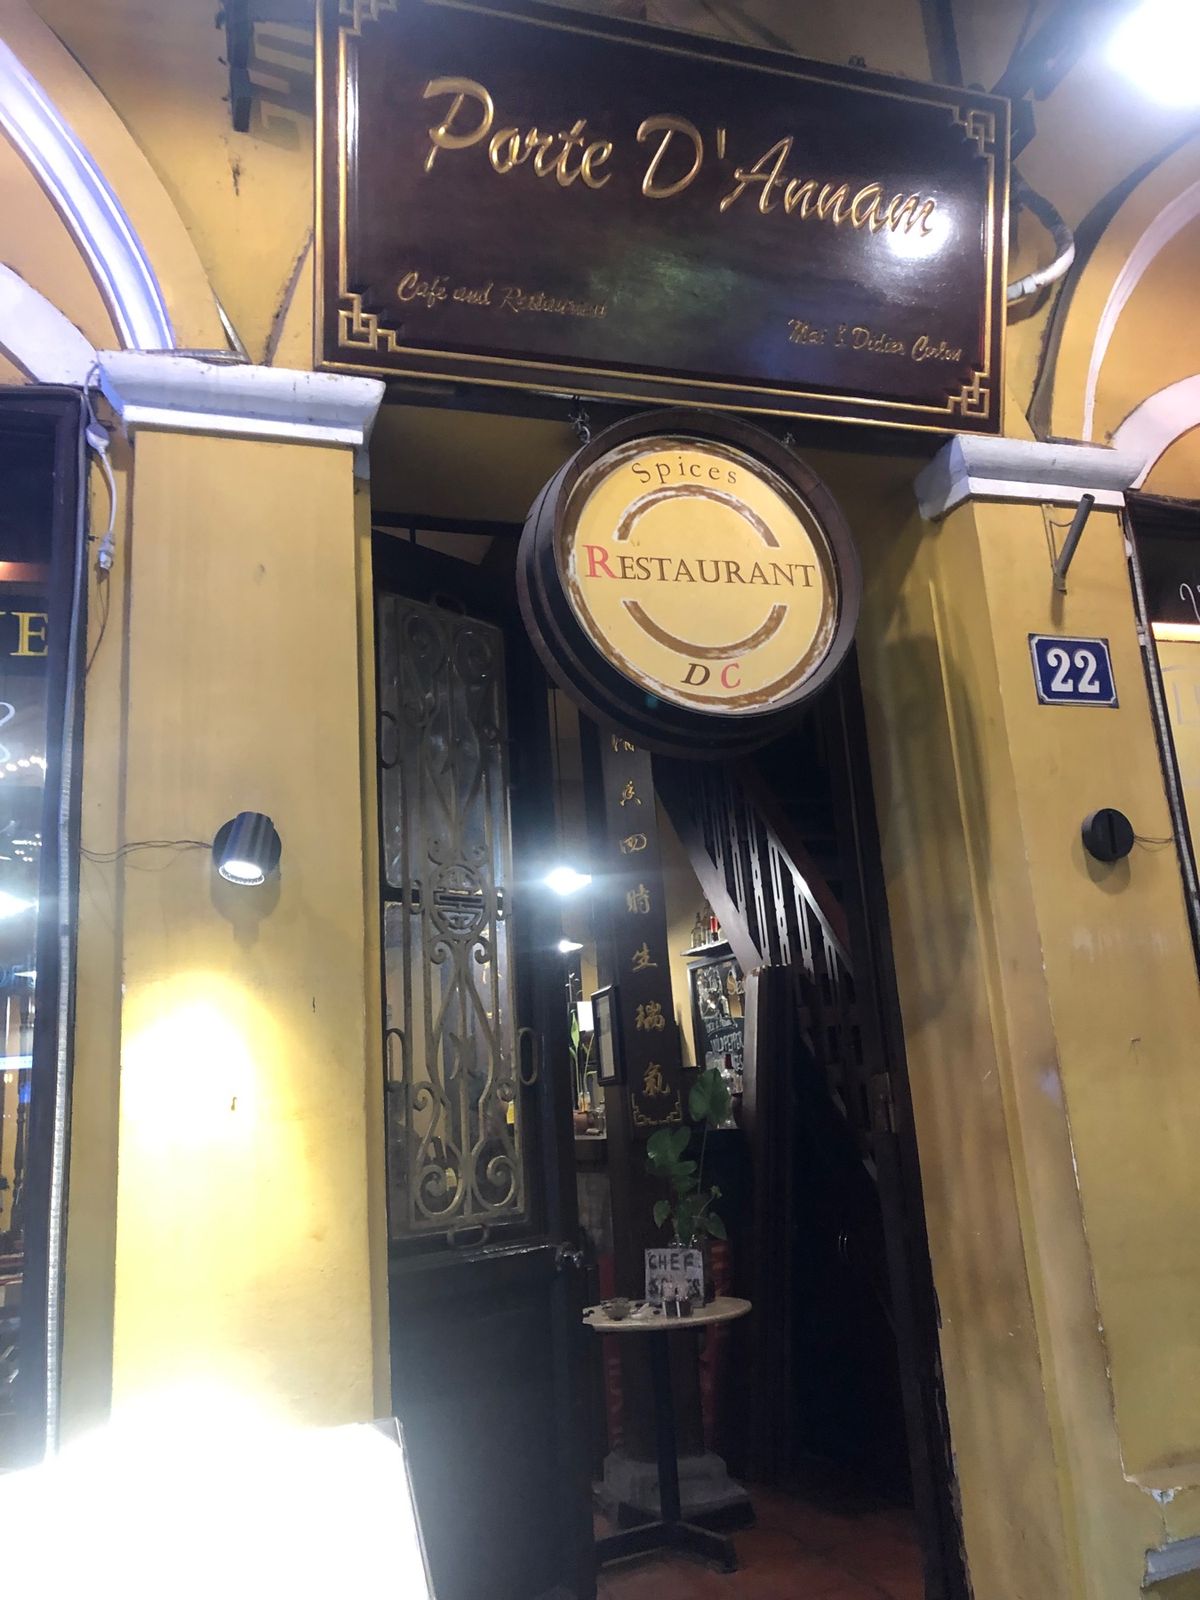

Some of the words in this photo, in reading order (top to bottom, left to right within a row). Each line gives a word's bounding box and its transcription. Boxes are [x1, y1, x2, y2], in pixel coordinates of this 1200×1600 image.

[422, 76, 613, 190] Porte
[635, 114, 938, 238] D'Annam
[397, 271, 448, 308] Café
[452, 282, 493, 305] and
[631, 456, 737, 485] Spices
[582, 544, 815, 589] RESTAURANT
[1046, 648, 1100, 694] 22
